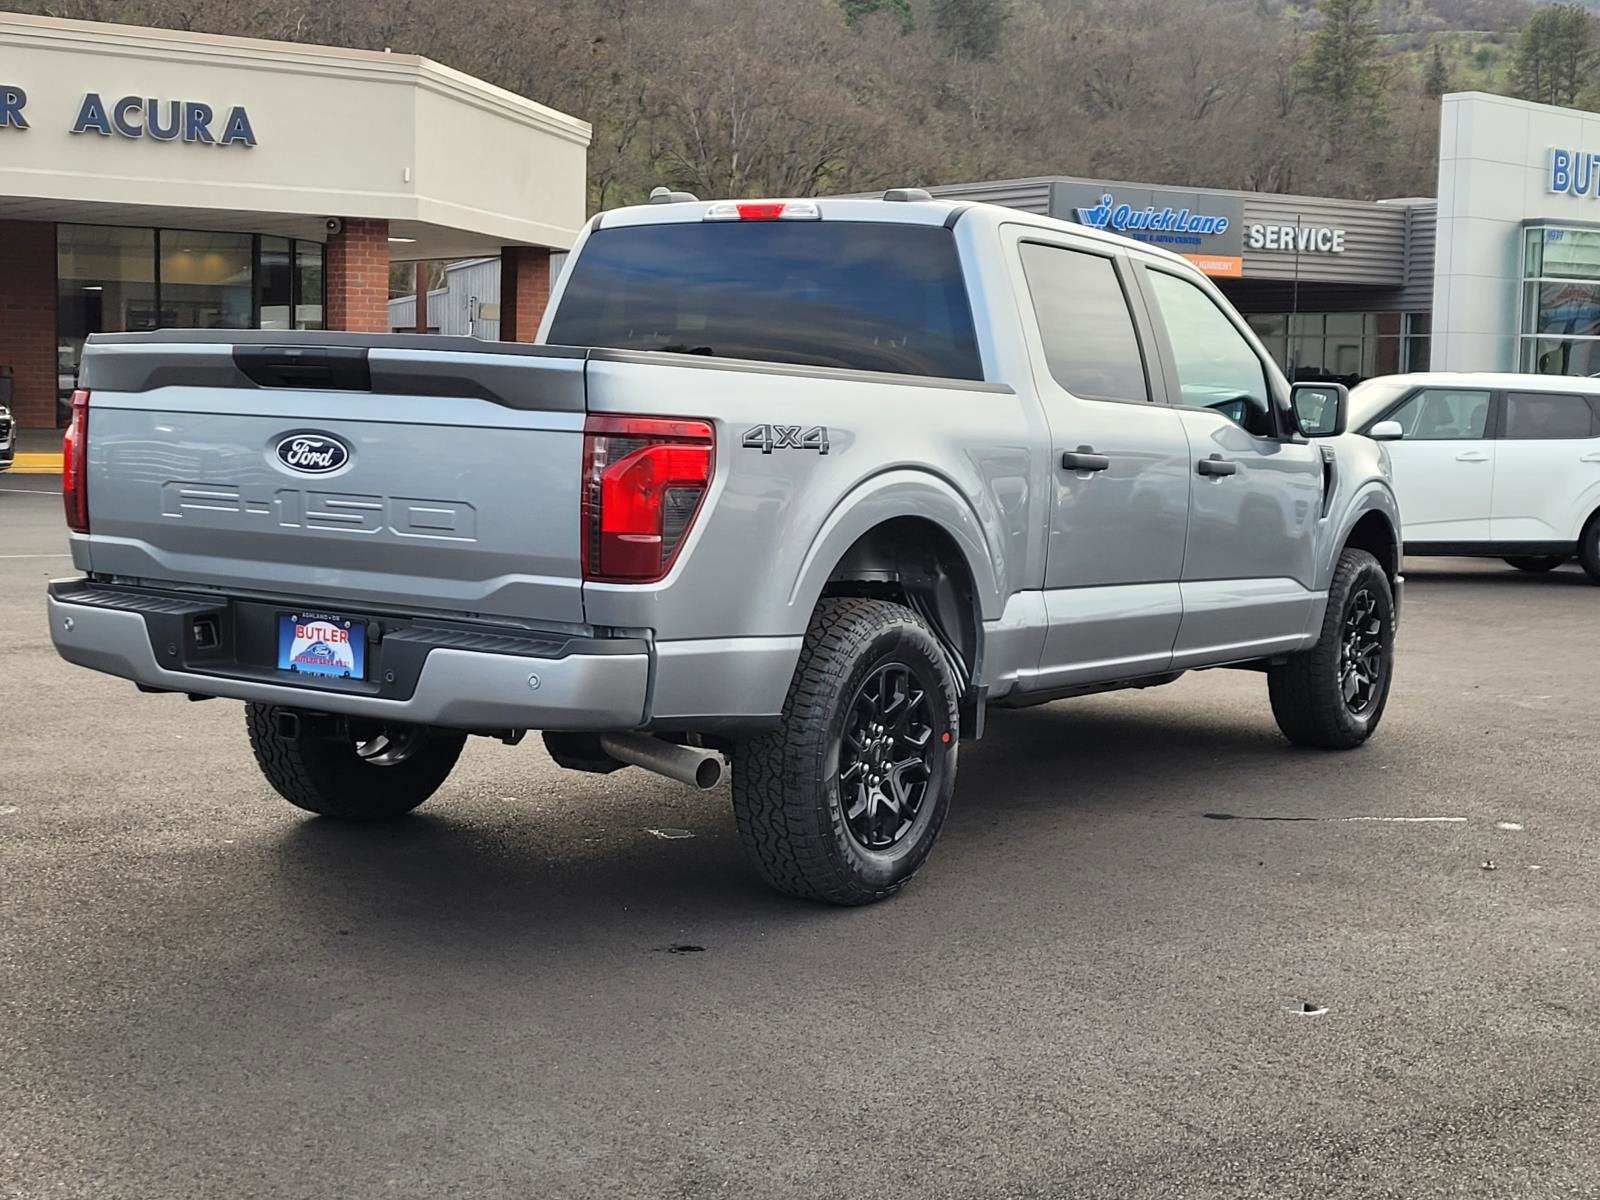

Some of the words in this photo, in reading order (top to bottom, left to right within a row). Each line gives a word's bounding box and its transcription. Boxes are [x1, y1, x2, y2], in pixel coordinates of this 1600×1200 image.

[69, 92, 258, 147] ACURA
[1249, 224, 1346, 252] SERVICE
[284, 438, 334, 468] Ford
[161, 480, 477, 542] F-150
[296, 625, 349, 643] BUTLER
